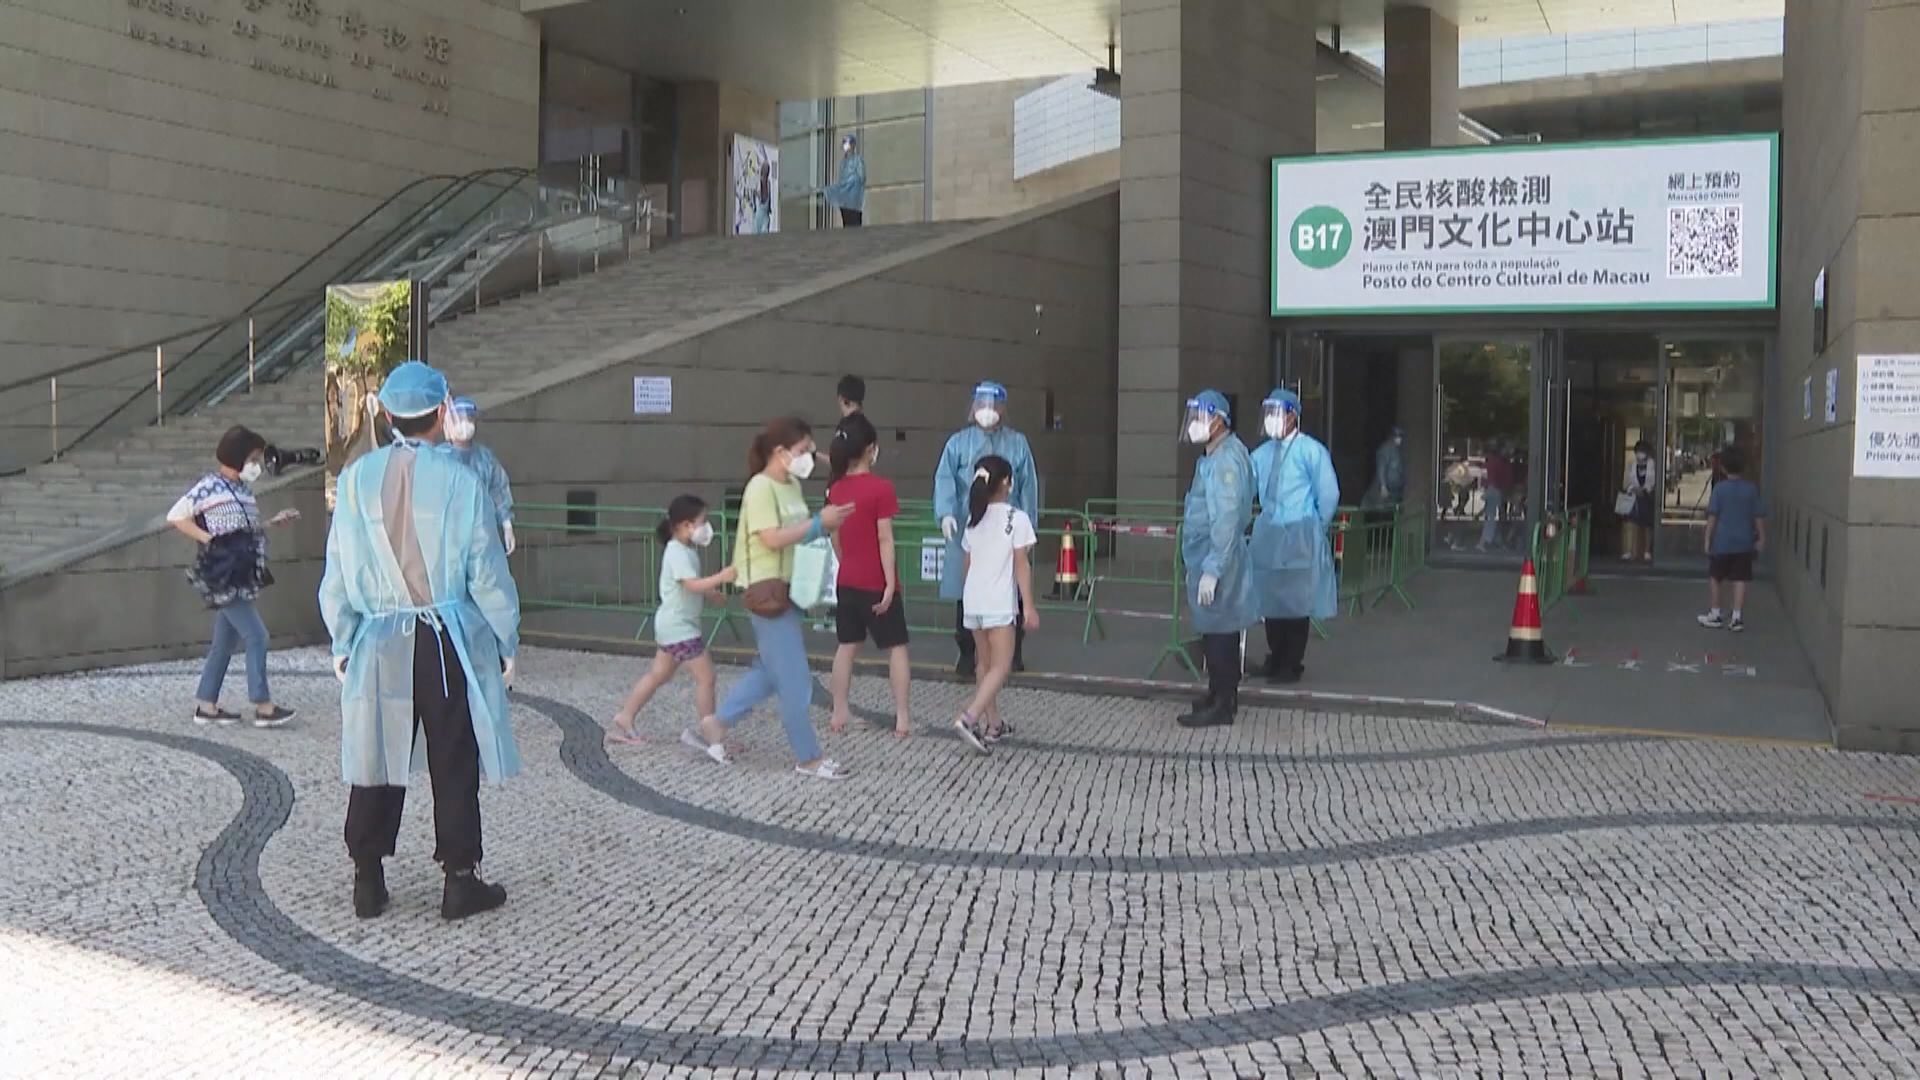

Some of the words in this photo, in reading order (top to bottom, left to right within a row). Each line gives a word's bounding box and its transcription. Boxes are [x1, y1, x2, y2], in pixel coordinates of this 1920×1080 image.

[1667, 171, 1740, 191] 網上預約
[1364, 174, 1551, 212] 全民核酸檢測
[1710, 190, 1740, 200] Online
[1298, 223, 1344, 251] B17
[1363, 207, 1635, 252] 澳門文化中心站
[1362, 260, 1393, 273] Plano
[1395, 259, 1409, 272] de
[1411, 260, 1433, 272] TAN
[1435, 261, 1460, 273] para
[1463, 258, 1489, 271] toda
[1491, 261, 1498, 270] a
[1500, 257, 1560, 271] população
[1363, 273, 1408, 289] Posto
[1411, 272, 1433, 288] do
[1436, 272, 1492, 288] Centro
[1496, 269, 1562, 288] Cultural
[1567, 268, 1588, 285] de
[1593, 267, 1650, 285] Macau
[1866, 450, 1902, 463] Priority
